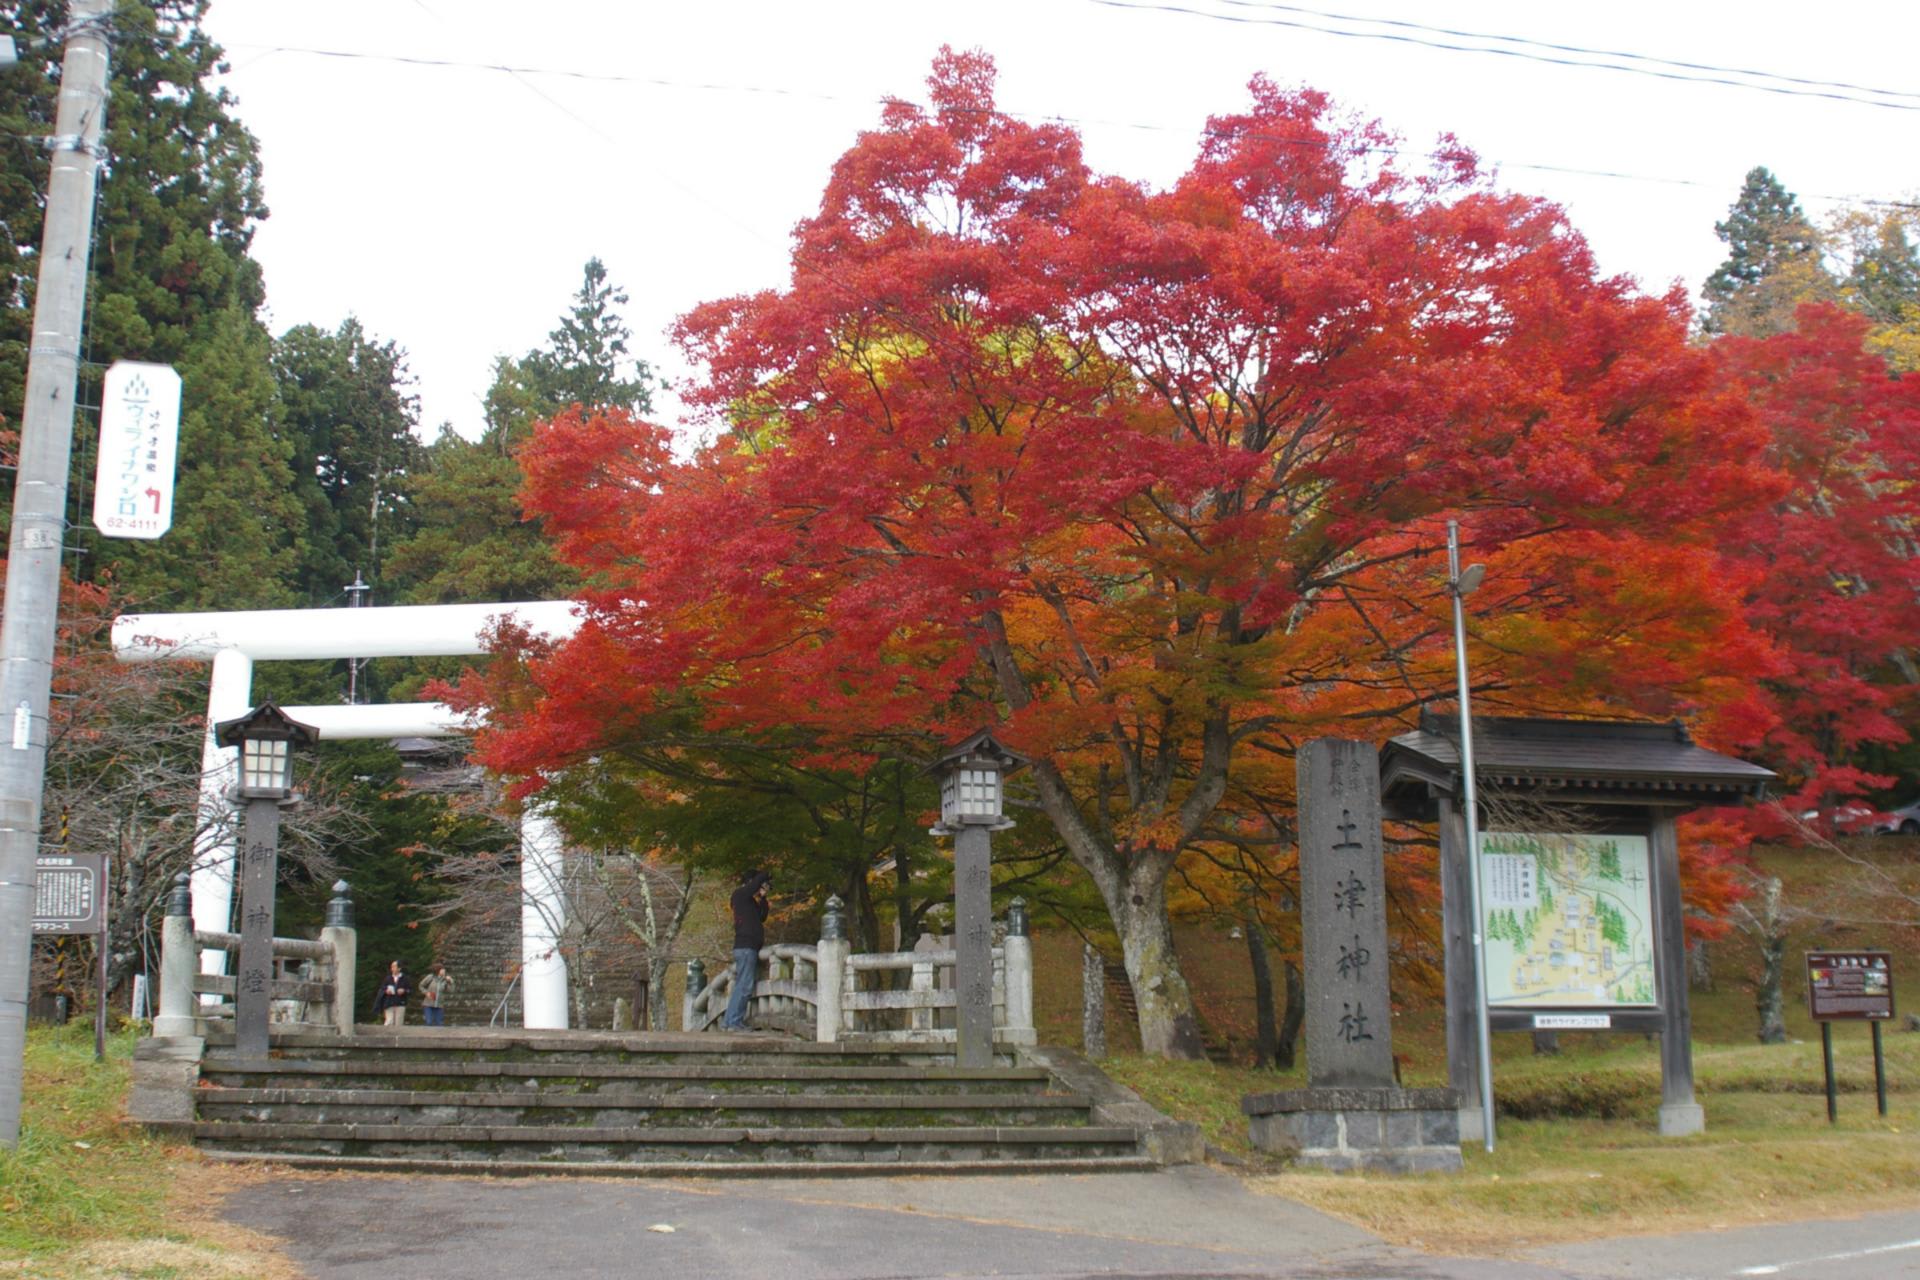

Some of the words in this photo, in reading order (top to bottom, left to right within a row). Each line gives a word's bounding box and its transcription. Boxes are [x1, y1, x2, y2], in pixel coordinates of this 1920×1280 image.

[31, 922, 70, 931] ラマコース
[1331, 808, 1373, 1042] 土津神社
